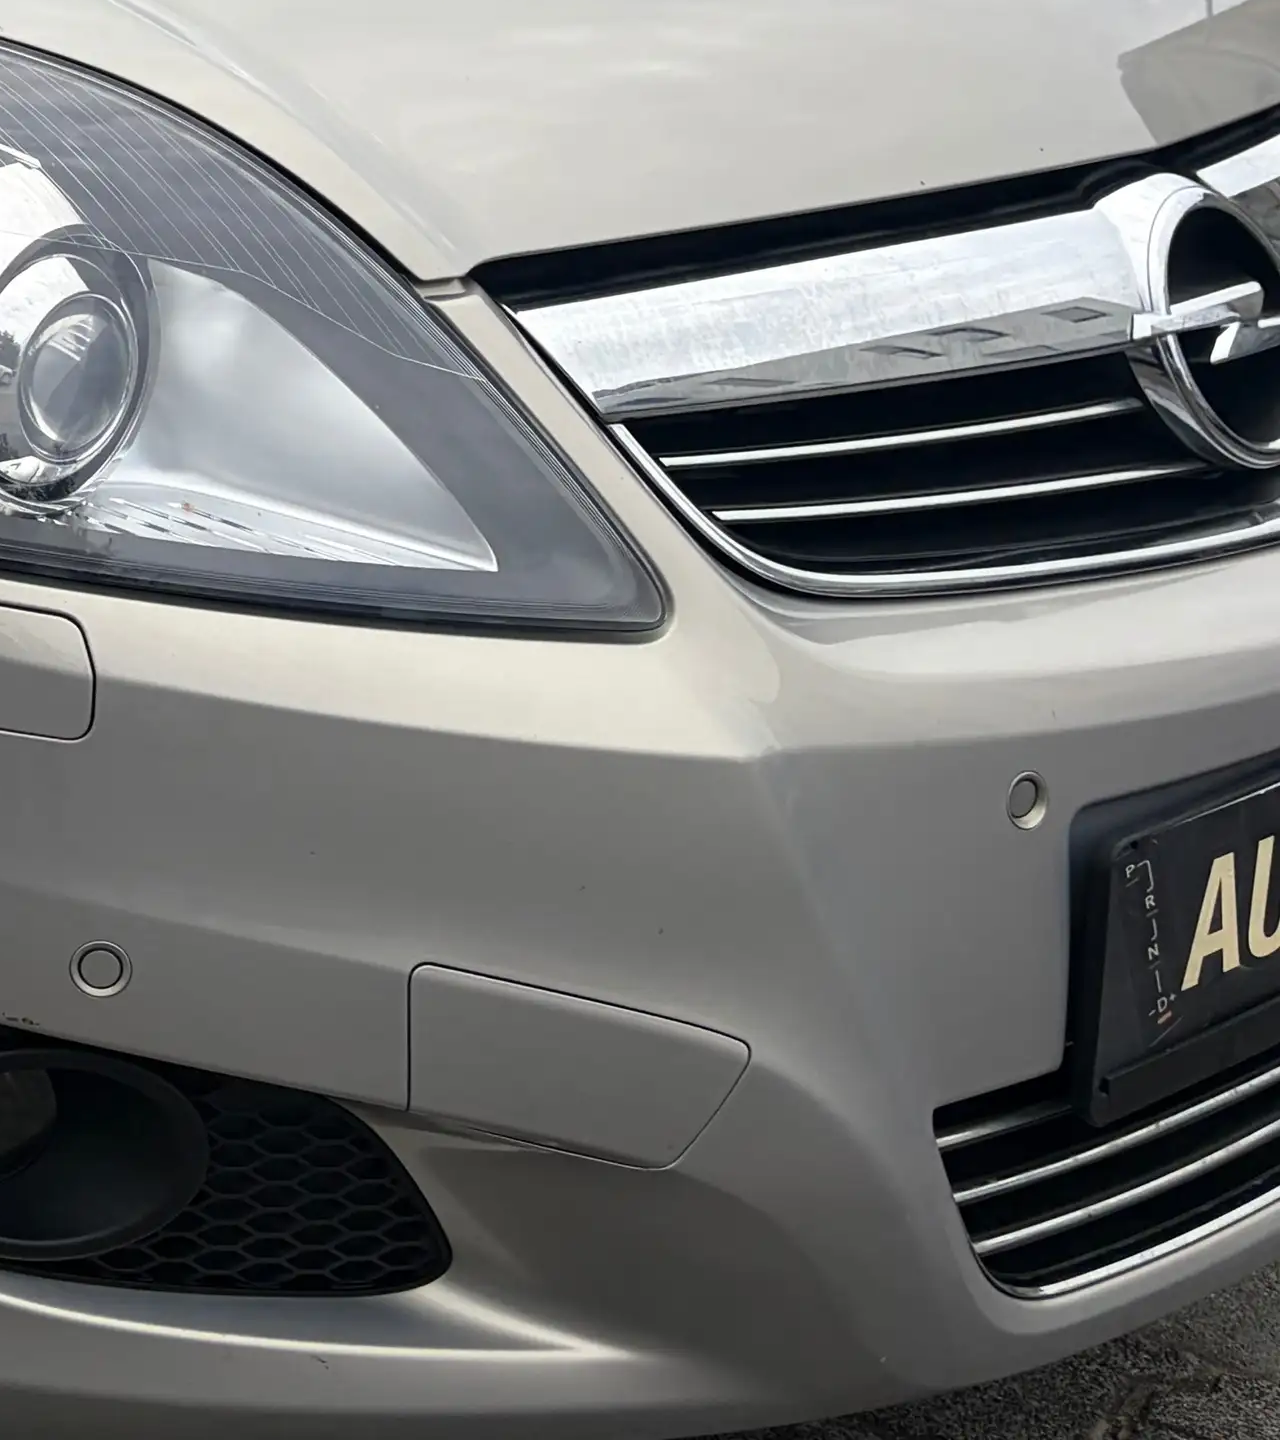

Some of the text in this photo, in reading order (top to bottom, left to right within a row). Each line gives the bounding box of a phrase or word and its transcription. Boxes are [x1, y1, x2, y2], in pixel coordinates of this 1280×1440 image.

[1125, 863, 1136, 879] P
[1144, 894, 1156, 910] R
[1147, 943, 1160, 961] N
